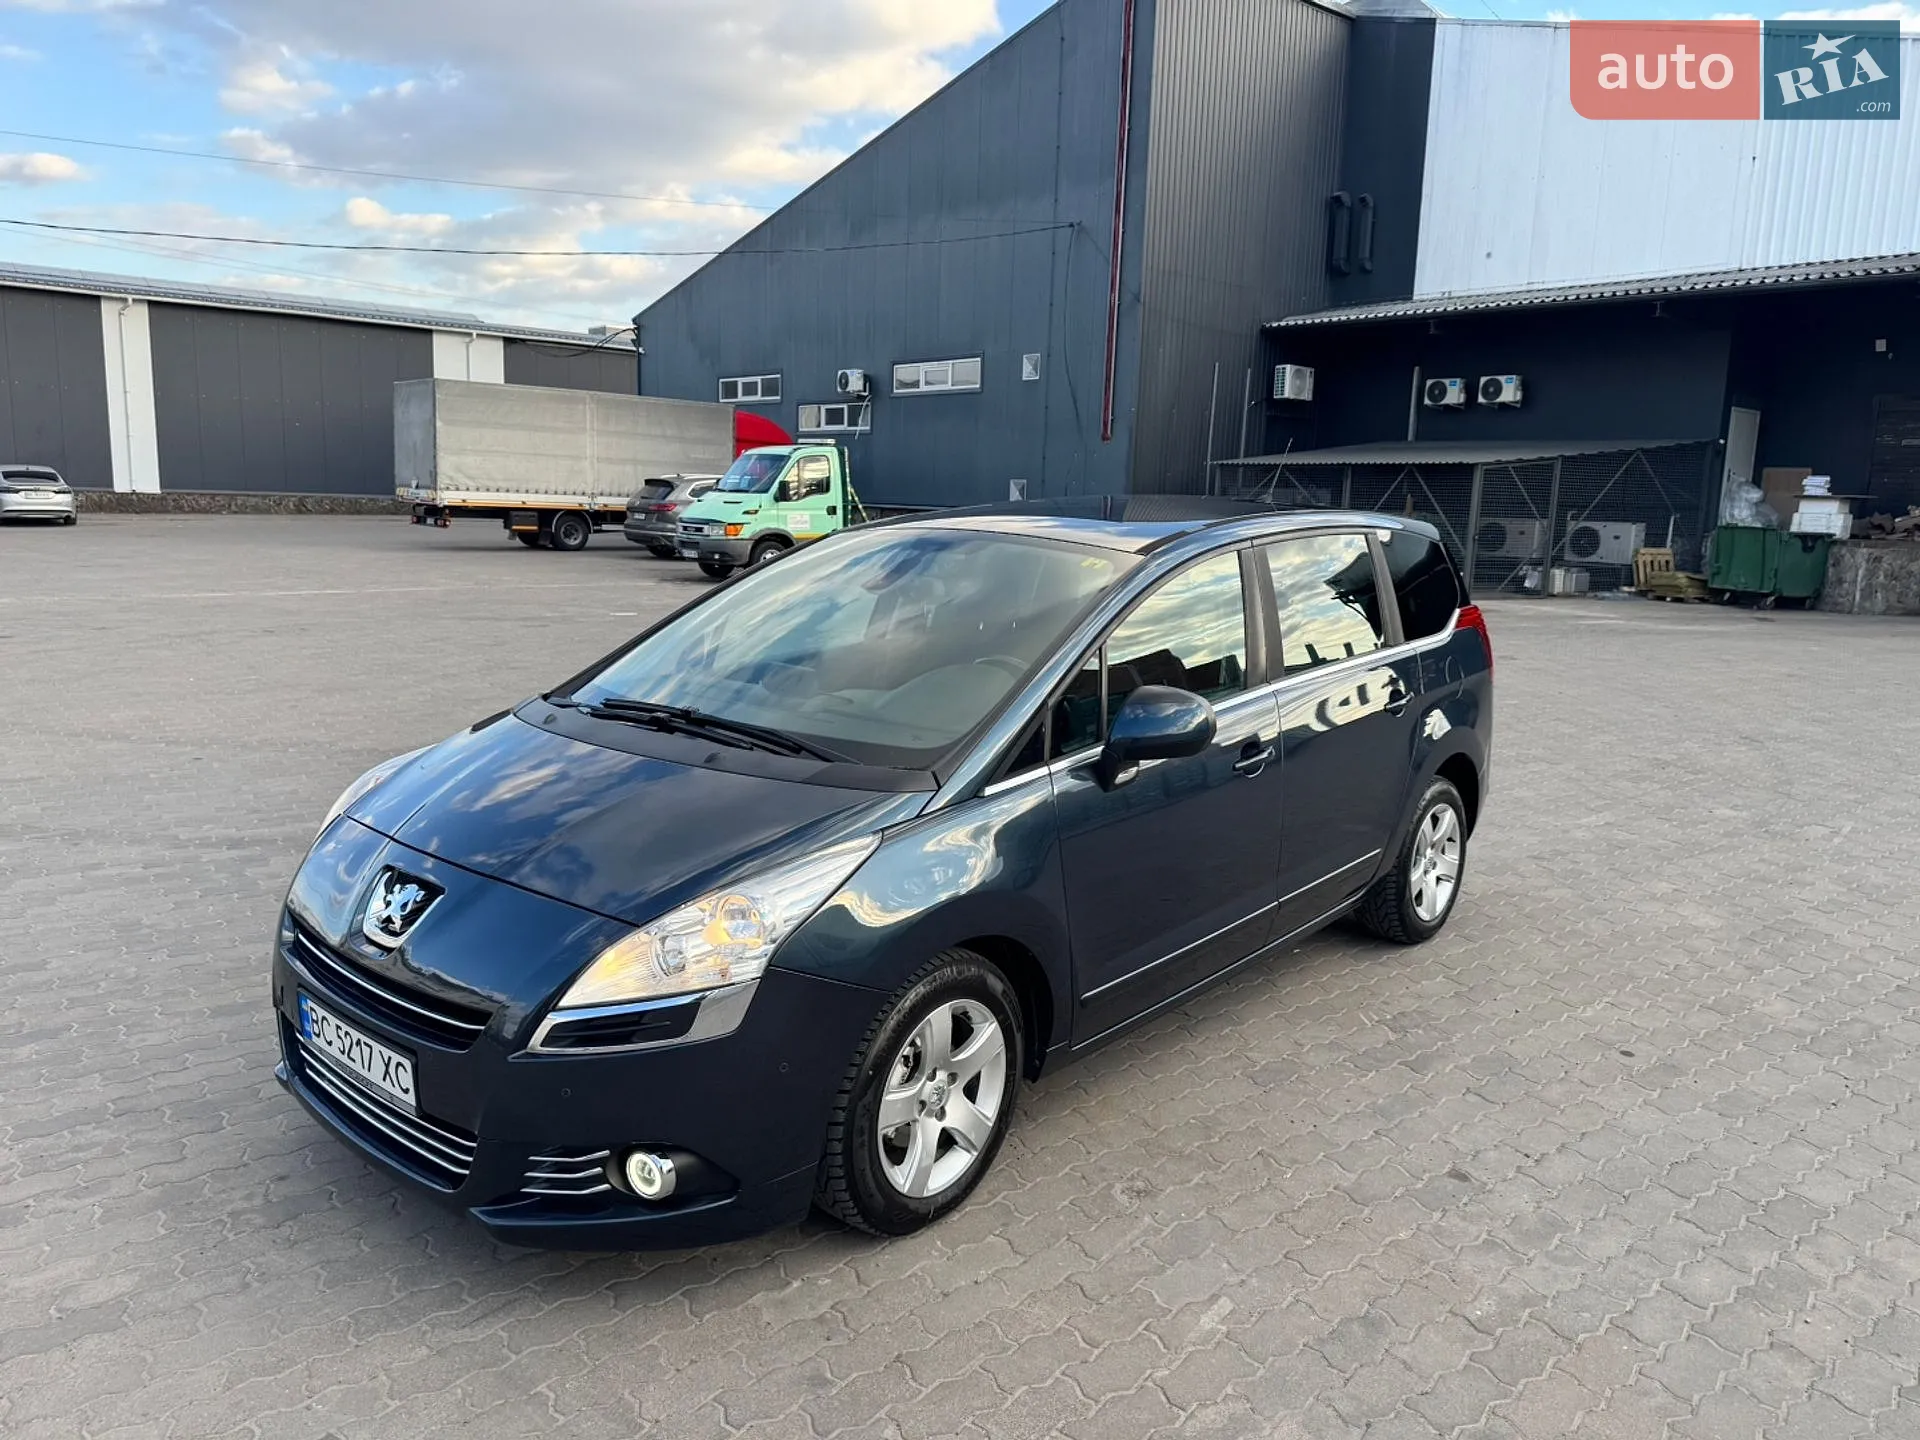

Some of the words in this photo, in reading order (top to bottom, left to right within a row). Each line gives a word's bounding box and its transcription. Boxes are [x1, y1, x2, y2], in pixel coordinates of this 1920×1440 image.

[310, 1006, 333, 1047] BC
[336, 1024, 373, 1073] 5217
[379, 1050, 410, 1095] XC
